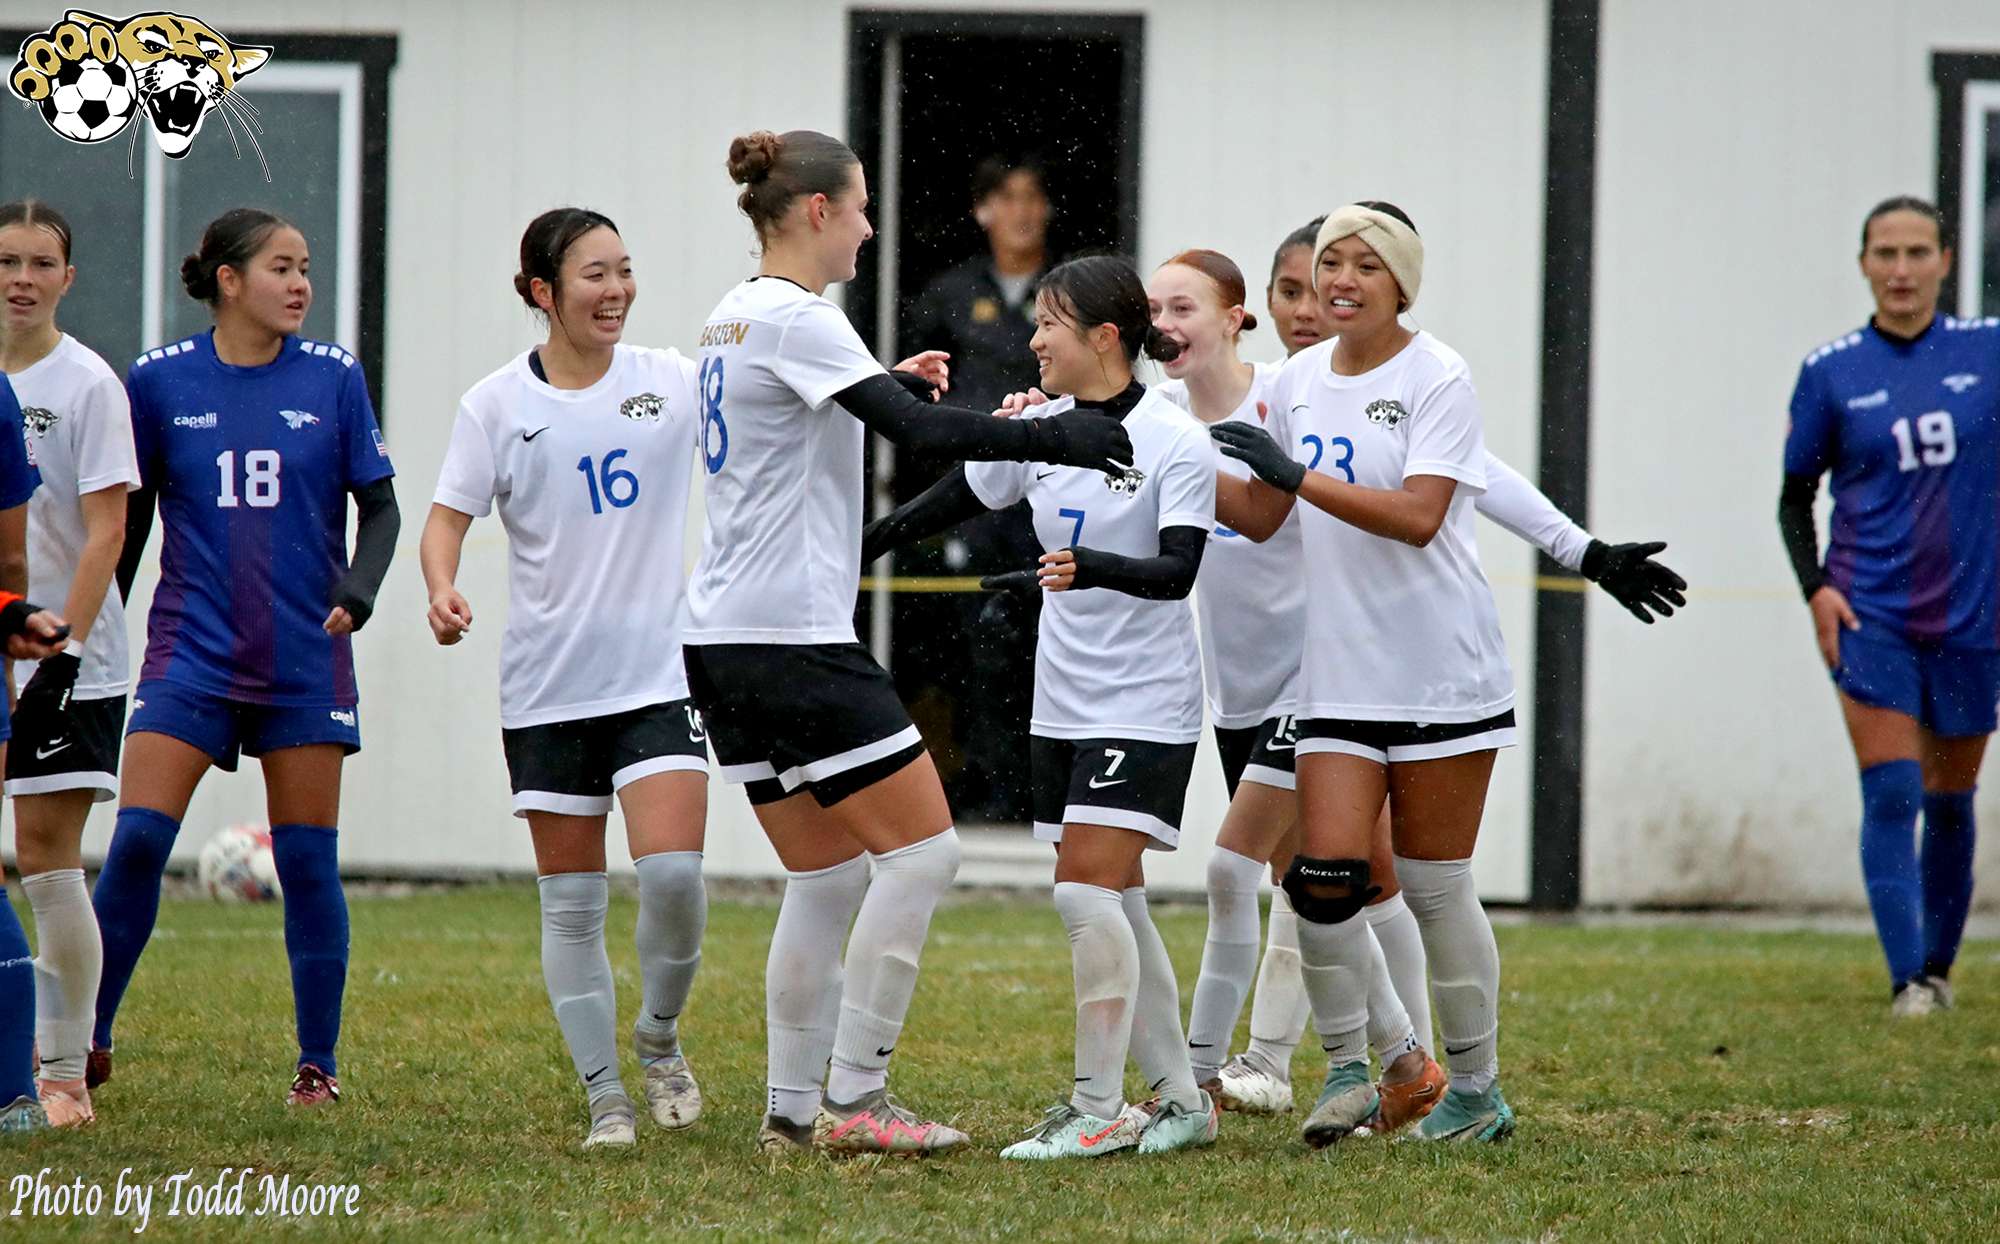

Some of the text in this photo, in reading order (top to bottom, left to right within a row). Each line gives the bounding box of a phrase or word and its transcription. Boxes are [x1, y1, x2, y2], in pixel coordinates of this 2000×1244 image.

[173, 412, 217, 428] capelli
[1891, 410, 1957, 472] 19
[216, 450, 281, 507] 18
[577, 448, 639, 514] 16
[1301, 434, 1355, 484] 23
[1059, 508, 1085, 548] 7
[1104, 748, 1126, 777] 7
[1305, 867, 1351, 877] MUELLER
